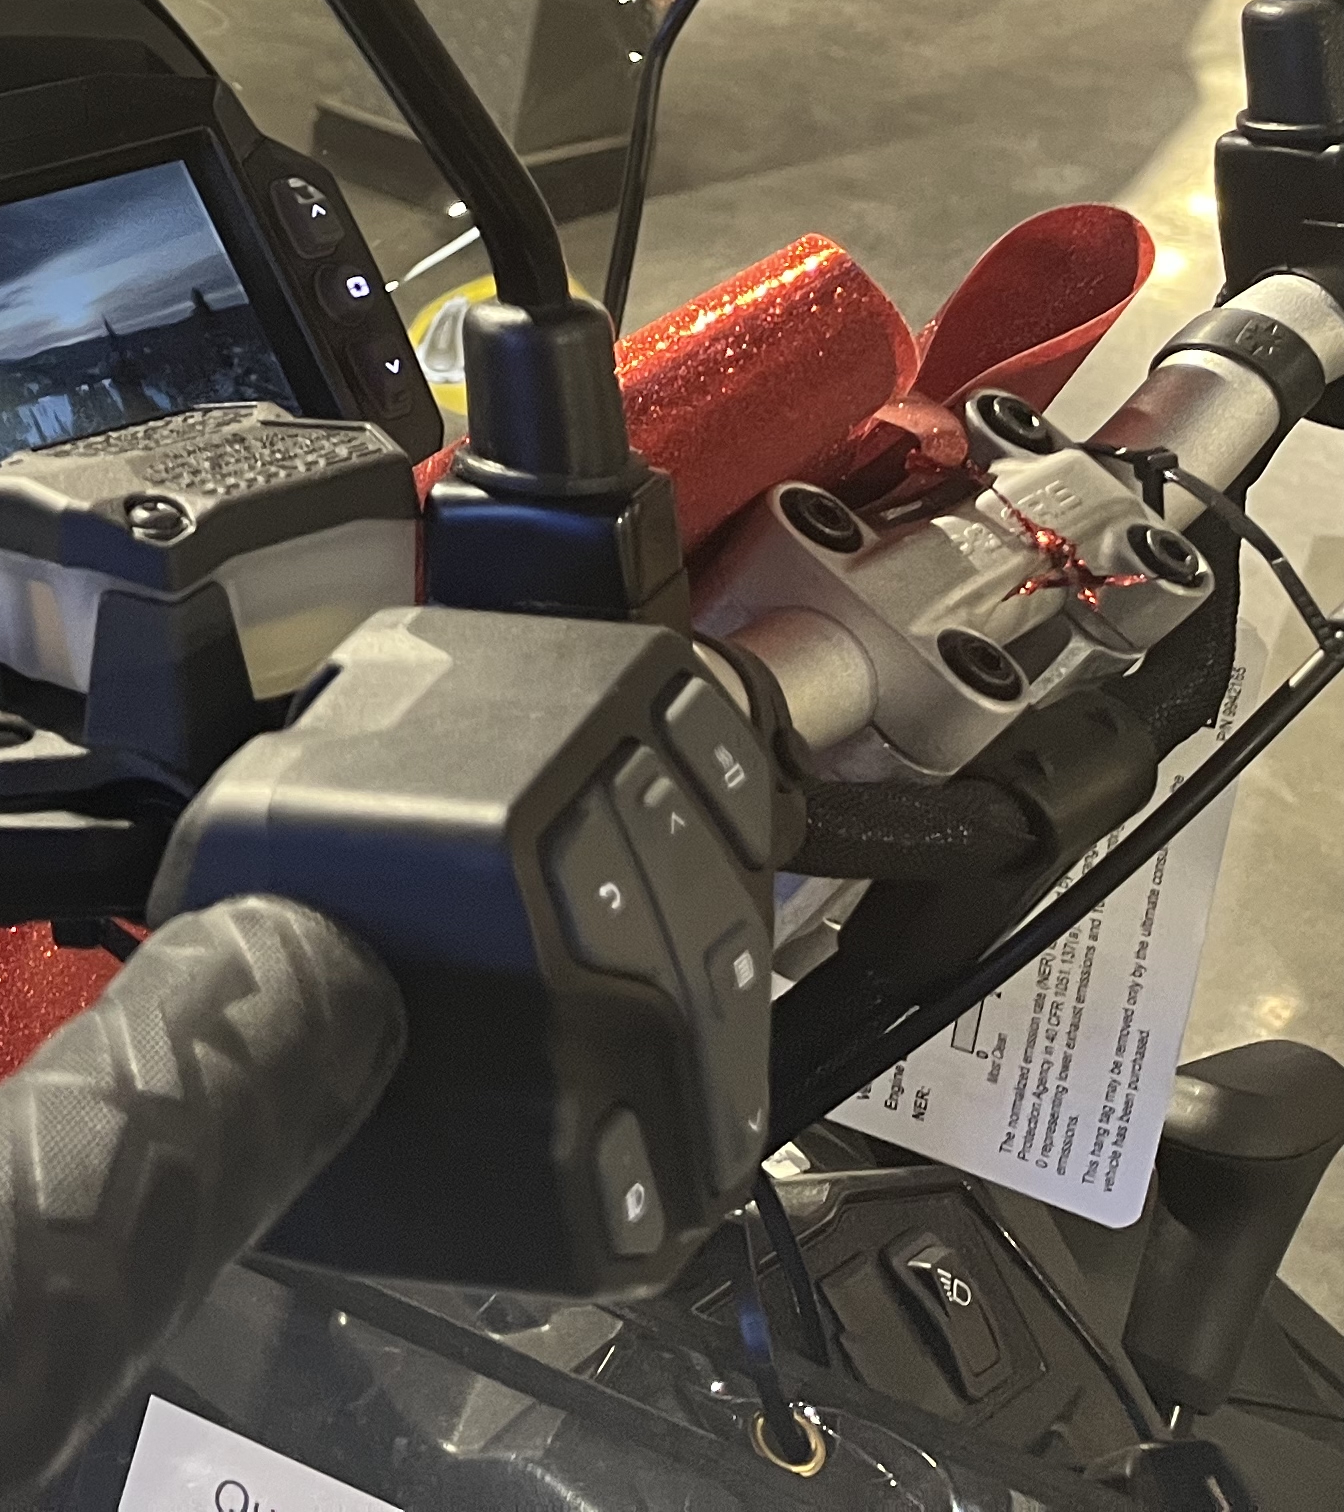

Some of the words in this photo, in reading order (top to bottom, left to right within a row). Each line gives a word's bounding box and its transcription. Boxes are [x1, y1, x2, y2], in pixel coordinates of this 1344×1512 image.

[1138, 888, 1160, 938] ultimate
[1088, 917, 1102, 943] and
[1134, 940, 1149, 961] the
[1075, 944, 1096, 1005] emissions
[1130, 962, 1148, 979] by
[1126, 979, 1144, 1007] only
[1064, 1005, 1086, 1050] exhaust
[1115, 1007, 1135, 1058] removed
[999, 1131, 1016, 1154] The
[1008, 1065, 1030, 1129] normalized
[1022, 1016, 1041, 1064] emission
[1035, 952, 1057, 990] (NER)
[1058, 1046, 1074, 1081] lower
[1109, 1058, 1123, 1076] be
[884, 1064, 905, 1111] Engine
[1017, 1101, 1043, 1162] Protection
[1033, 1059, 1054, 1101] Agency
[1047, 1001, 1066, 1027] CFR
[1104, 1076, 1122, 1103] may
[1040, 1084, 1068, 1158] representing
[1098, 1104, 1116, 1127] tag
[1117, 1092, 1135, 1124] been
[1089, 1126, 1111, 1158] hang
[1111, 1124, 1129, 1149] has
[1081, 1158, 1101, 1185] This
[1103, 1148, 1122, 1193] vehicle
